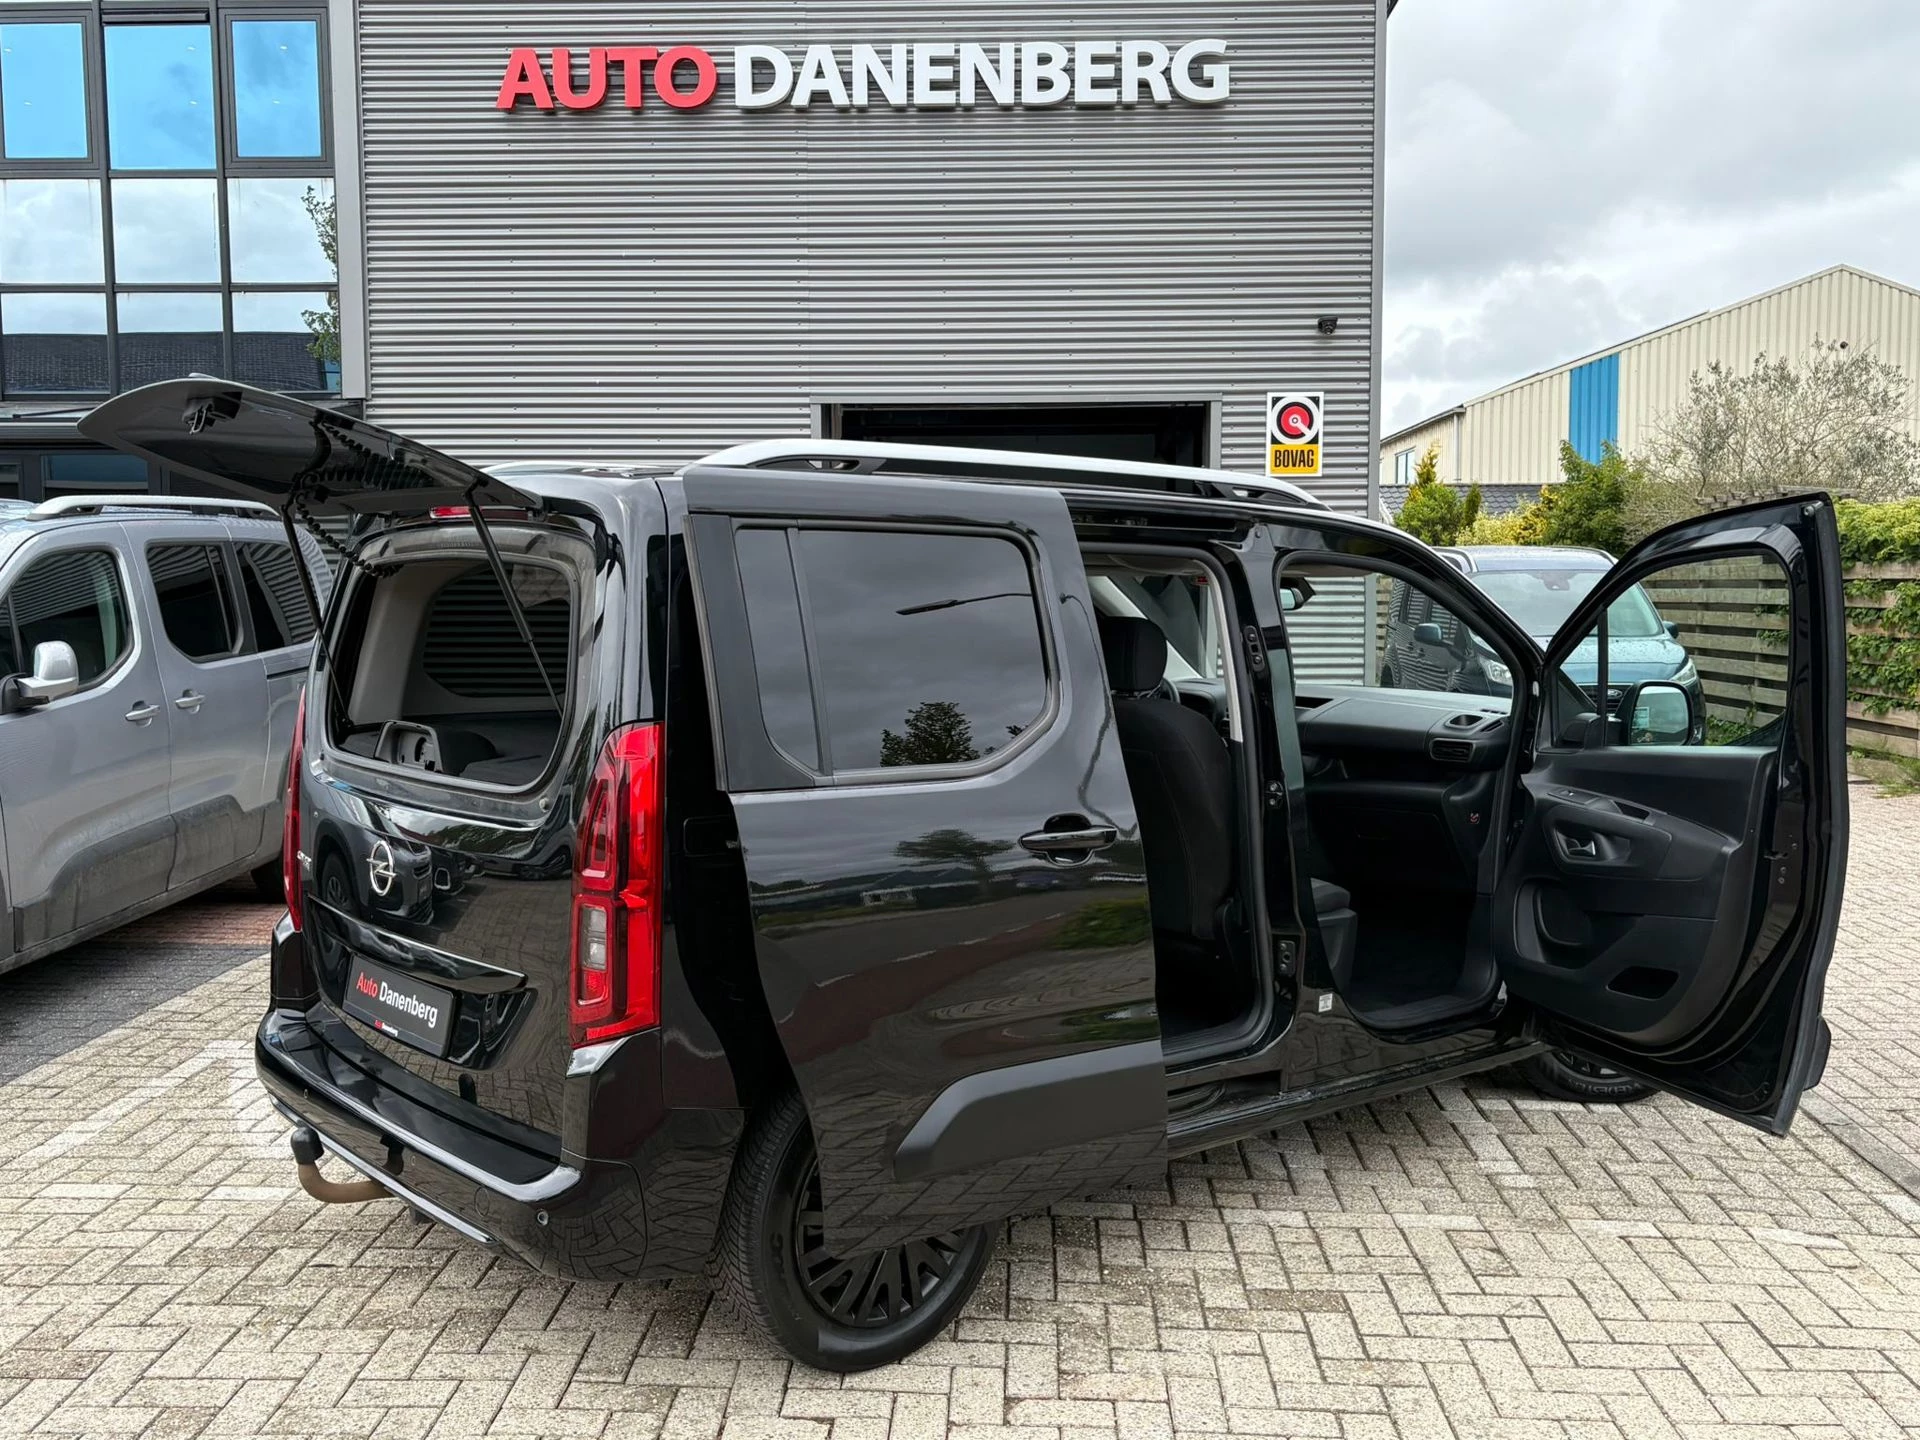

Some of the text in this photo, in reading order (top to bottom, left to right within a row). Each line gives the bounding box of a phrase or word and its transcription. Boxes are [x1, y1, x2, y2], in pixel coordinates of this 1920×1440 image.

[497, 38, 1231, 110] AUTO DANENBERG
[1274, 449, 1315, 468] BOVAG
[356, 972, 378, 998] Auto
[379, 981, 438, 1028] Danenberg
